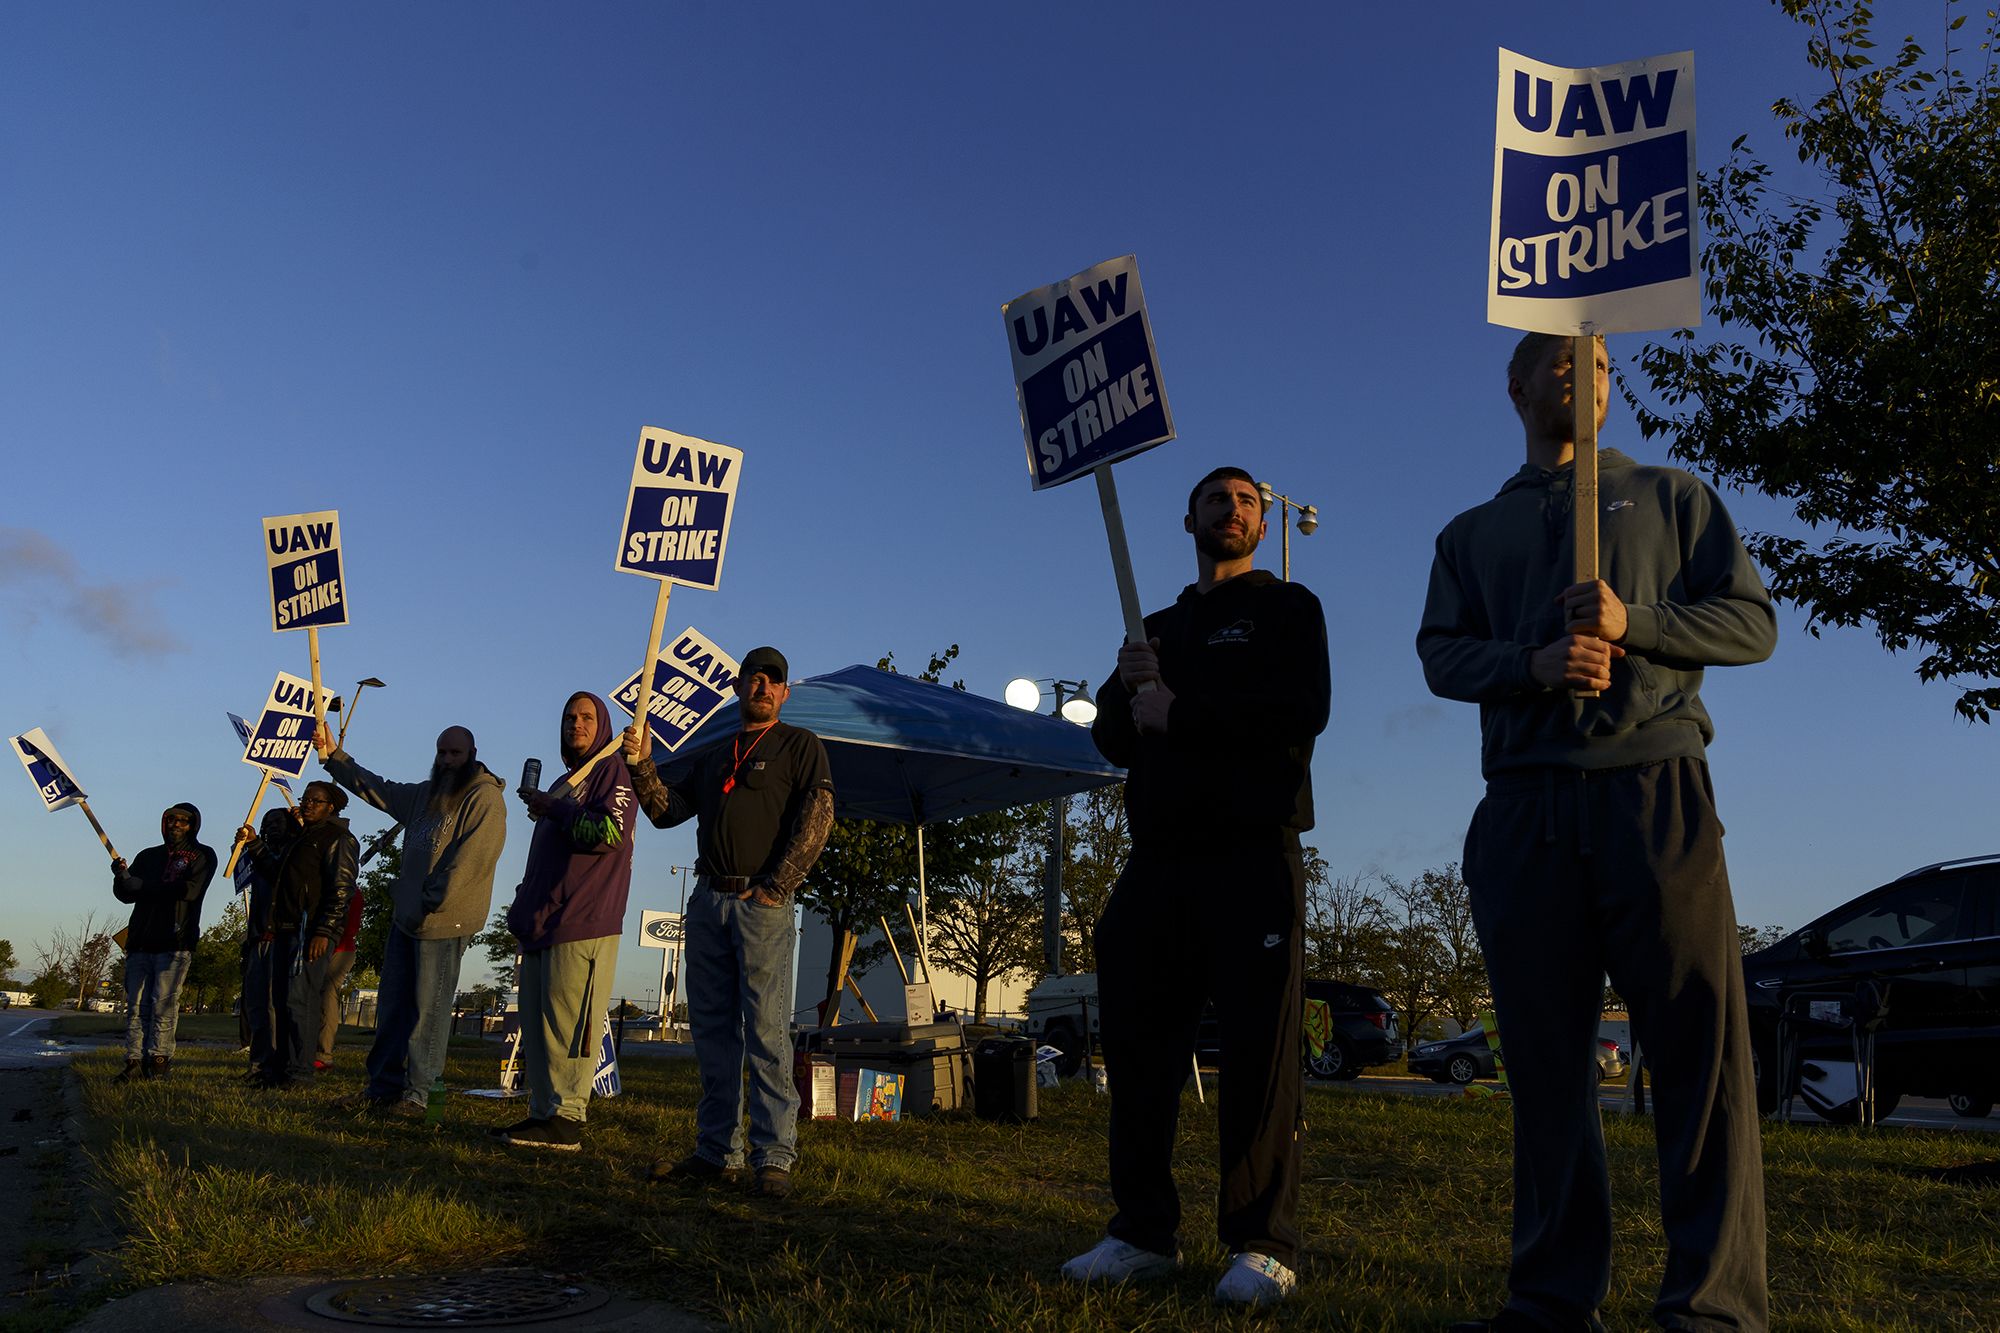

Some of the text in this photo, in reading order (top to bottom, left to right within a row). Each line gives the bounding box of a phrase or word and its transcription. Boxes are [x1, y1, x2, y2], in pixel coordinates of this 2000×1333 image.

[1513, 69, 1679, 138] UAW
[1546, 155, 1619, 222] ON
[1499, 187, 1688, 289] STRIKE
[1013, 272, 1128, 356] UAW
[1062, 341, 1109, 404] ON
[1038, 362, 1155, 474] STRIKE
[642, 438, 732, 489] UAW
[661, 496, 698, 527] ON
[269, 522, 333, 554] UAW
[627, 530, 719, 563] STRIKE
[293, 559, 319, 591] ON
[277, 579, 341, 625] STRIKE
[661, 676, 700, 702] ON
[250, 737, 309, 759] STRIKE
[276, 717, 303, 738] ON
